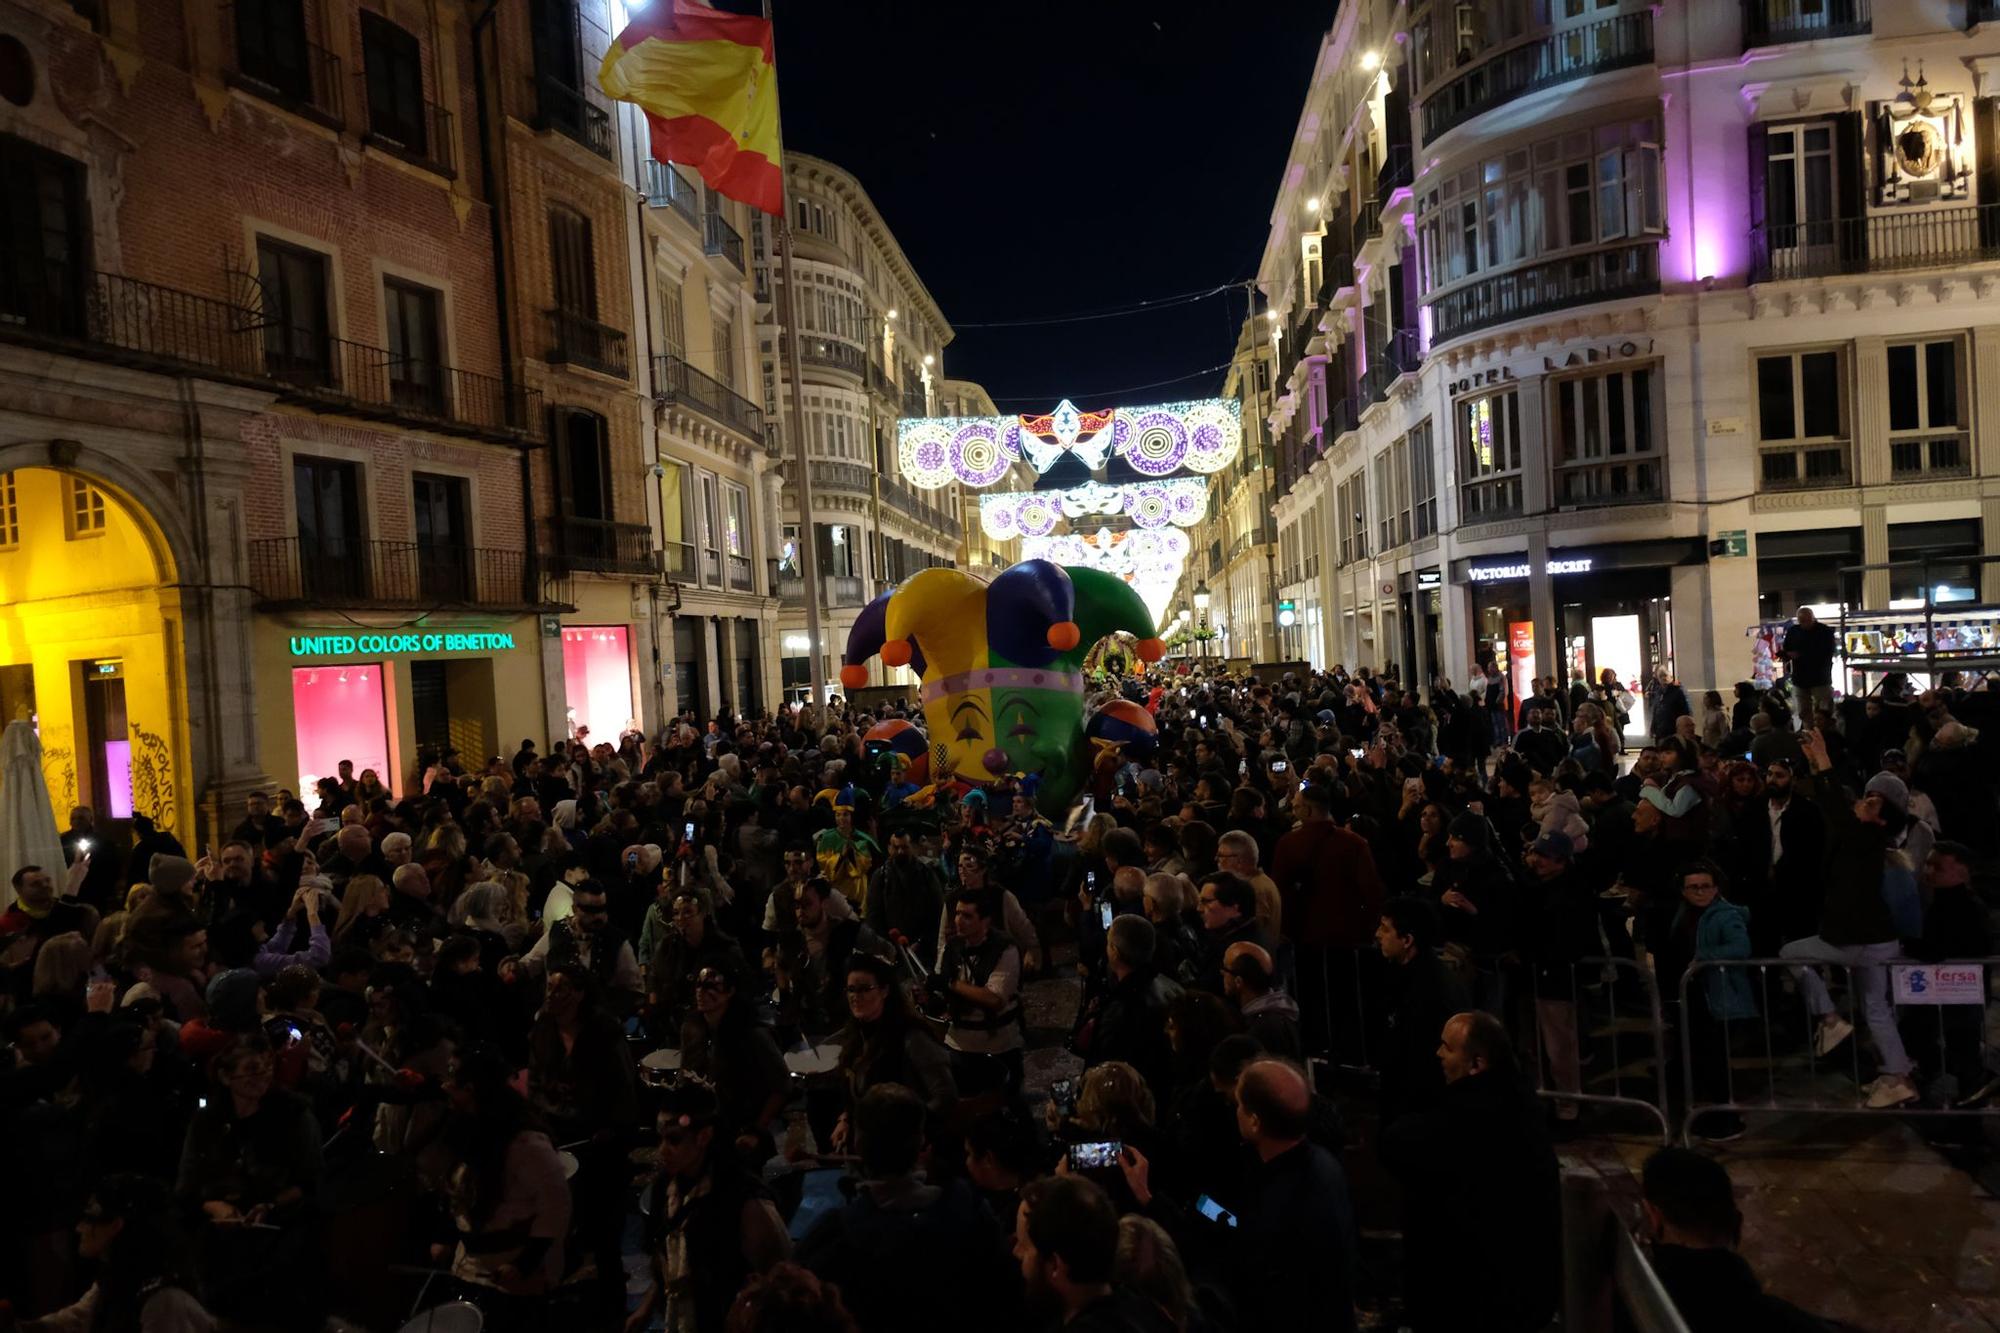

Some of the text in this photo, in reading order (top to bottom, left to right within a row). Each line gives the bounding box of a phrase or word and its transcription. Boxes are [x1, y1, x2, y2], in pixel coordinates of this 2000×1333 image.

[1449, 339, 1654, 396] HOTEL LARIOS
[1468, 559, 1592, 581] VICTORIA'S SECRET
[290, 636, 355, 655] UNITED
[358, 634, 420, 653] COLORS
[423, 634, 443, 651] OF
[1935, 968, 1976, 981] fersa
